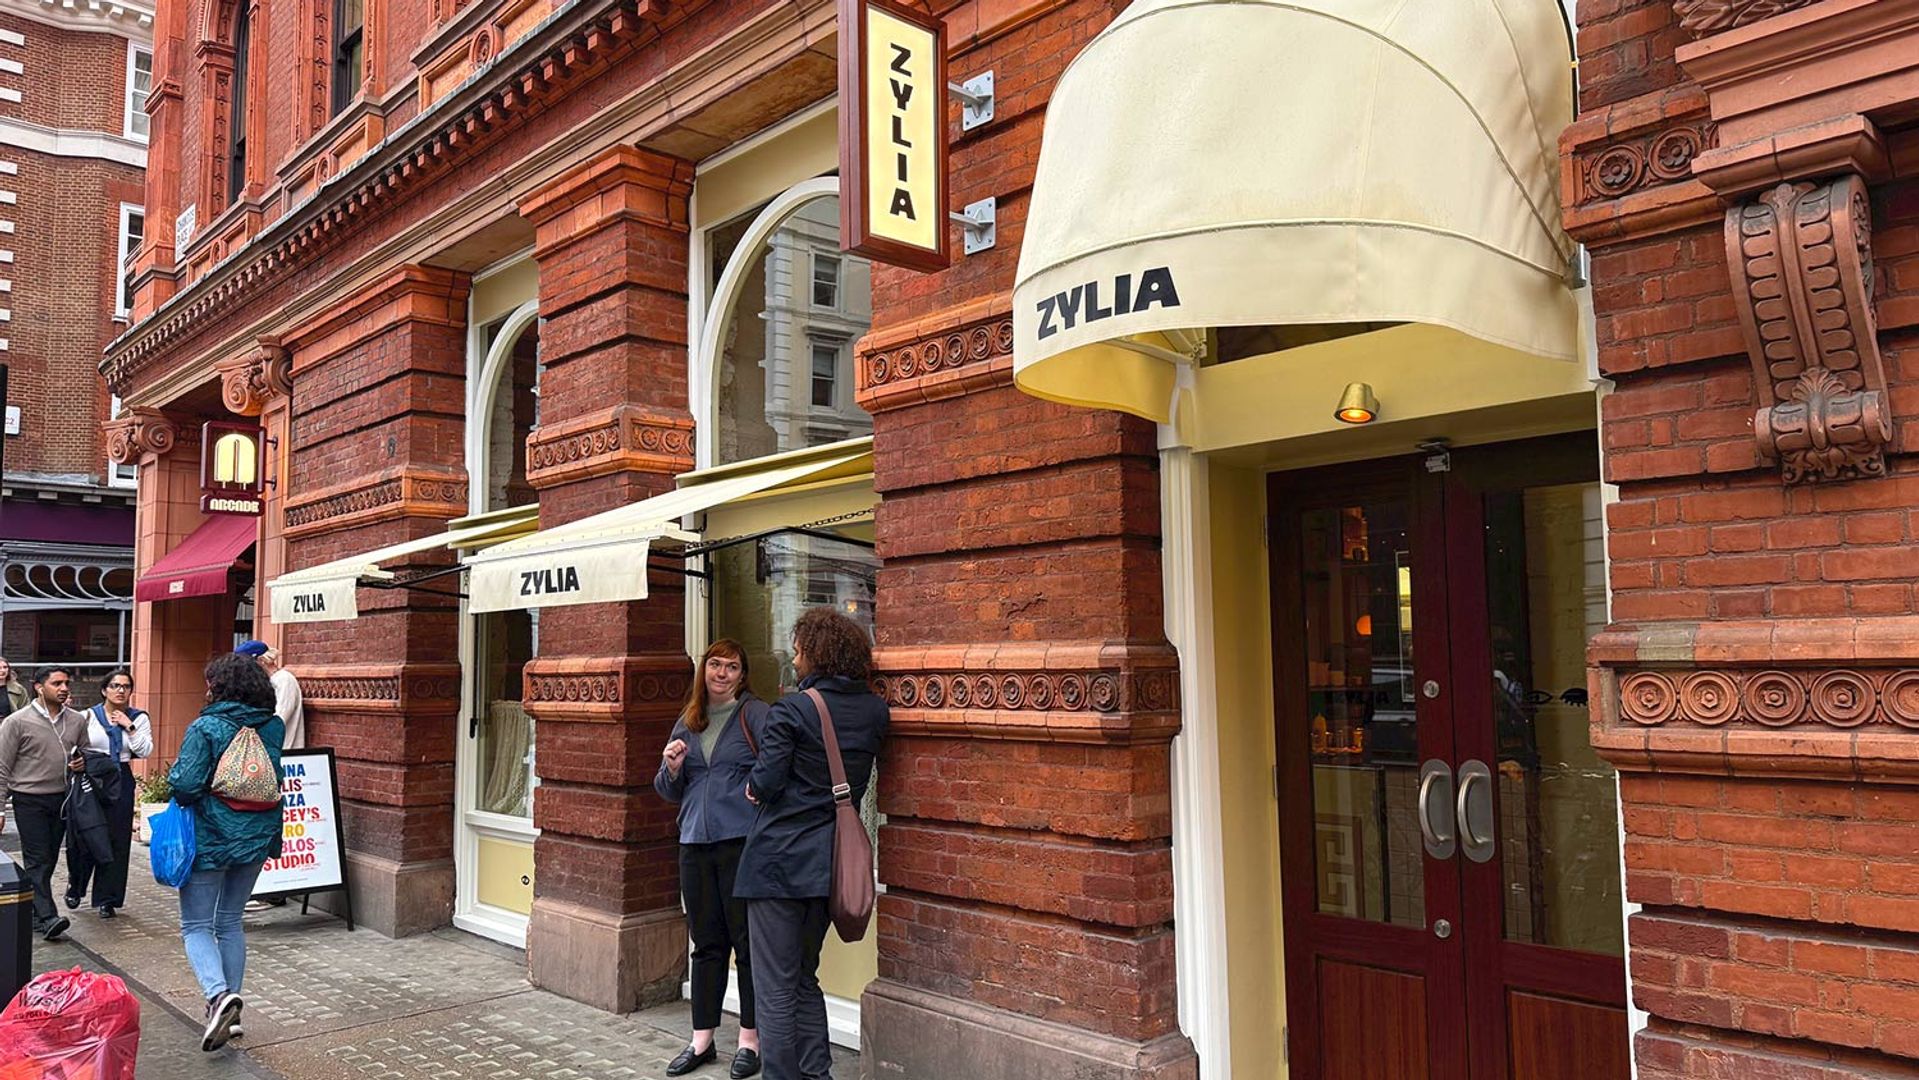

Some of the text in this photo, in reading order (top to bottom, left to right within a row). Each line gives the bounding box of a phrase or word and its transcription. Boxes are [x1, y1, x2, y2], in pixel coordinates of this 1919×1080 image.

[889, 42, 916, 221] ZYLIA
[1036, 266, 1181, 340] ZYLIA
[209, 498, 260, 513] ARCADE
[520, 566, 580, 596] ZYLIA
[293, 593, 326, 613] ZYLIA
[283, 824, 305, 838] RO
[263, 852, 316, 872] STUDIO
